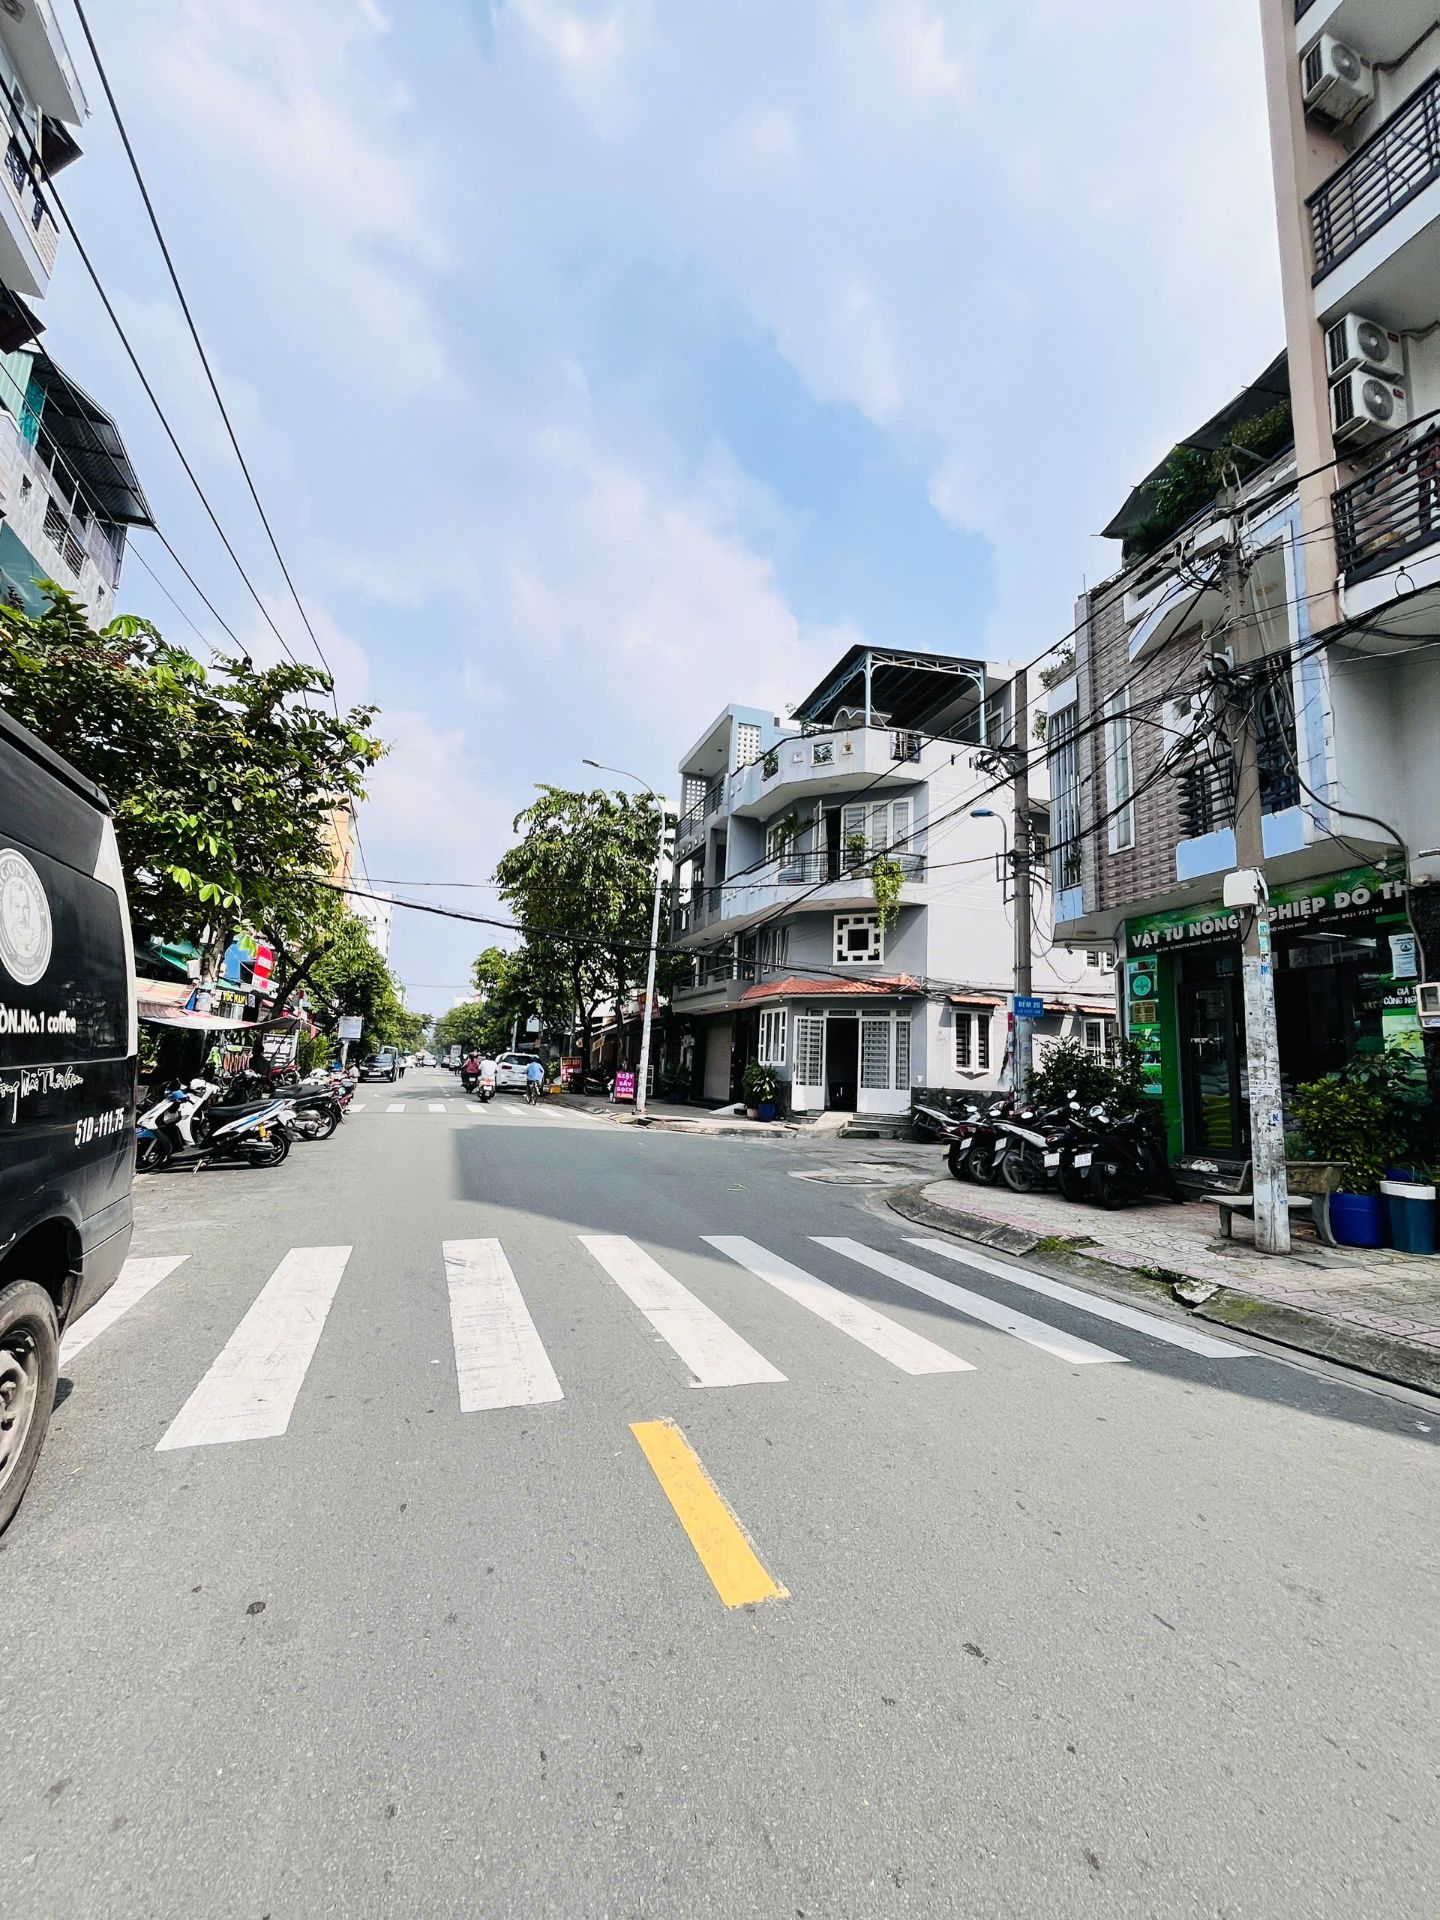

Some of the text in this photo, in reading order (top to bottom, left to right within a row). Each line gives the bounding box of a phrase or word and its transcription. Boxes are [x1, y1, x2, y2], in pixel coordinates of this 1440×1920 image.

[1131, 930, 1160, 949] VẬT
[1189, 914, 1240, 937] NÔNG
[1266, 896, 1326, 923] GHIỆP
[1334, 884, 1371, 909] ĐÔ
[1379, 880, 1411, 900] TH
[47, 1009, 77, 1034] coffee
[75, 1107, 125, 1147] 51D-111.75
